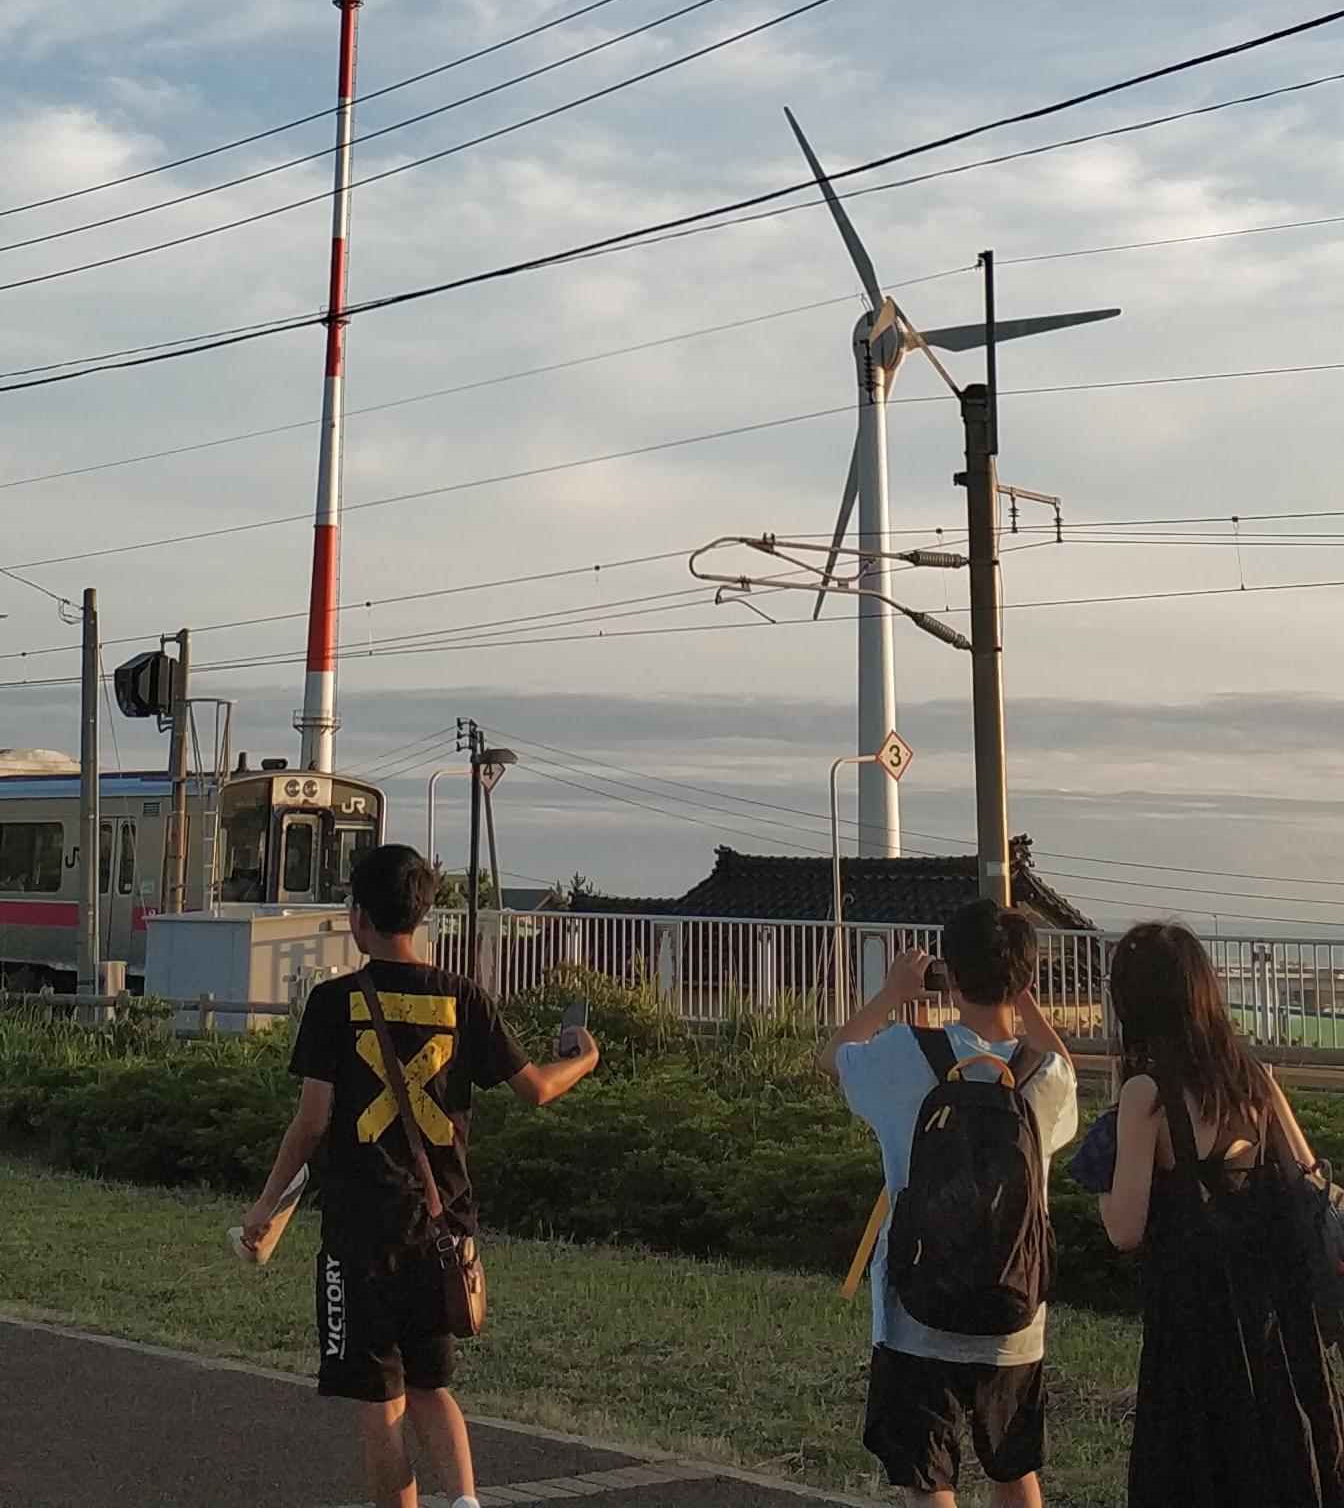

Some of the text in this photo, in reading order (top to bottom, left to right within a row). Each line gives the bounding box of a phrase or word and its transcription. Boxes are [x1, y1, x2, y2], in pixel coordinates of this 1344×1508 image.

[889, 744, 901, 767] 3
[483, 763, 494, 780] 4
[341, 796, 366, 814] JR
[326, 1253, 342, 1355] VICTORY
